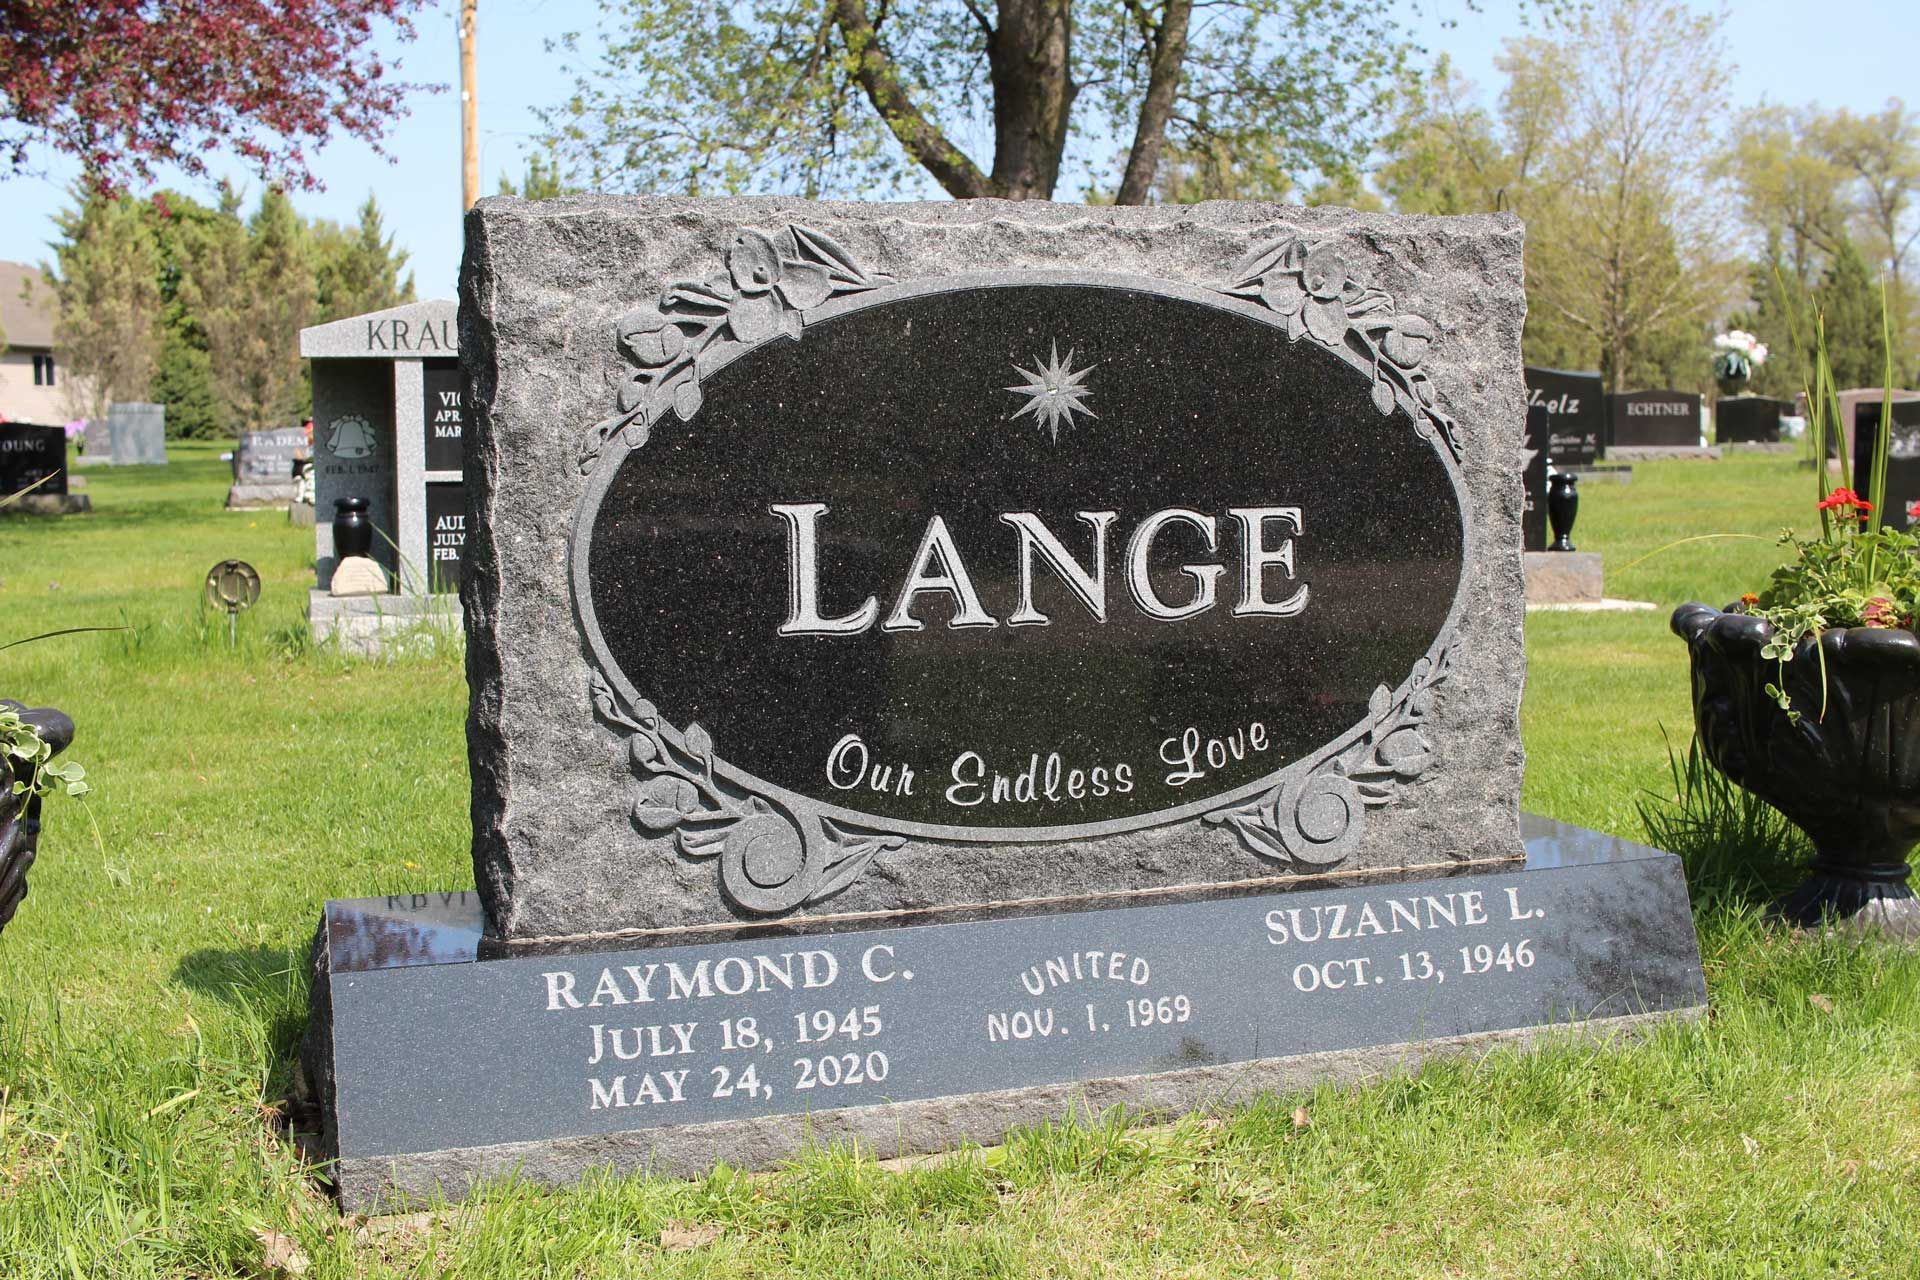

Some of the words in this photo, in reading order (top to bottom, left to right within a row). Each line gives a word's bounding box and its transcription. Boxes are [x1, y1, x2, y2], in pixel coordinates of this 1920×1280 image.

[1627, 402, 1690, 416] ECHTNER
[0, 439, 46, 453] OUNG
[433, 533, 466, 546] JULY
[433, 548, 460, 560] FEB.
[769, 502, 1310, 637] LANGE
[825, 732, 914, 796] Our
[944, 750, 1134, 807] Endless
[1159, 720, 1270, 786] Love
[1264, 890, 1489, 946] SUZANNE
[1502, 886, 1546, 921] L.
[541, 950, 839, 1012] RAYMOND
[860, 944, 915, 984] C.
[1020, 950, 1151, 997] UNITED
[1292, 957, 1384, 993] OCT.
[1399, 950, 1445, 985] 13,
[1460, 938, 1536, 975] 1946
[588, 1021, 699, 1065] JULY
[719, 1016, 774, 1055] 18,
[794, 1004, 884, 1044] 1945
[987, 1007, 1069, 1043] NOV.
[1127, 993, 1192, 1029] 1969
[589, 1069, 691, 1111] MAY
[710, 1063, 774, 1101] 24,
[793, 1049, 890, 1090] 2020
